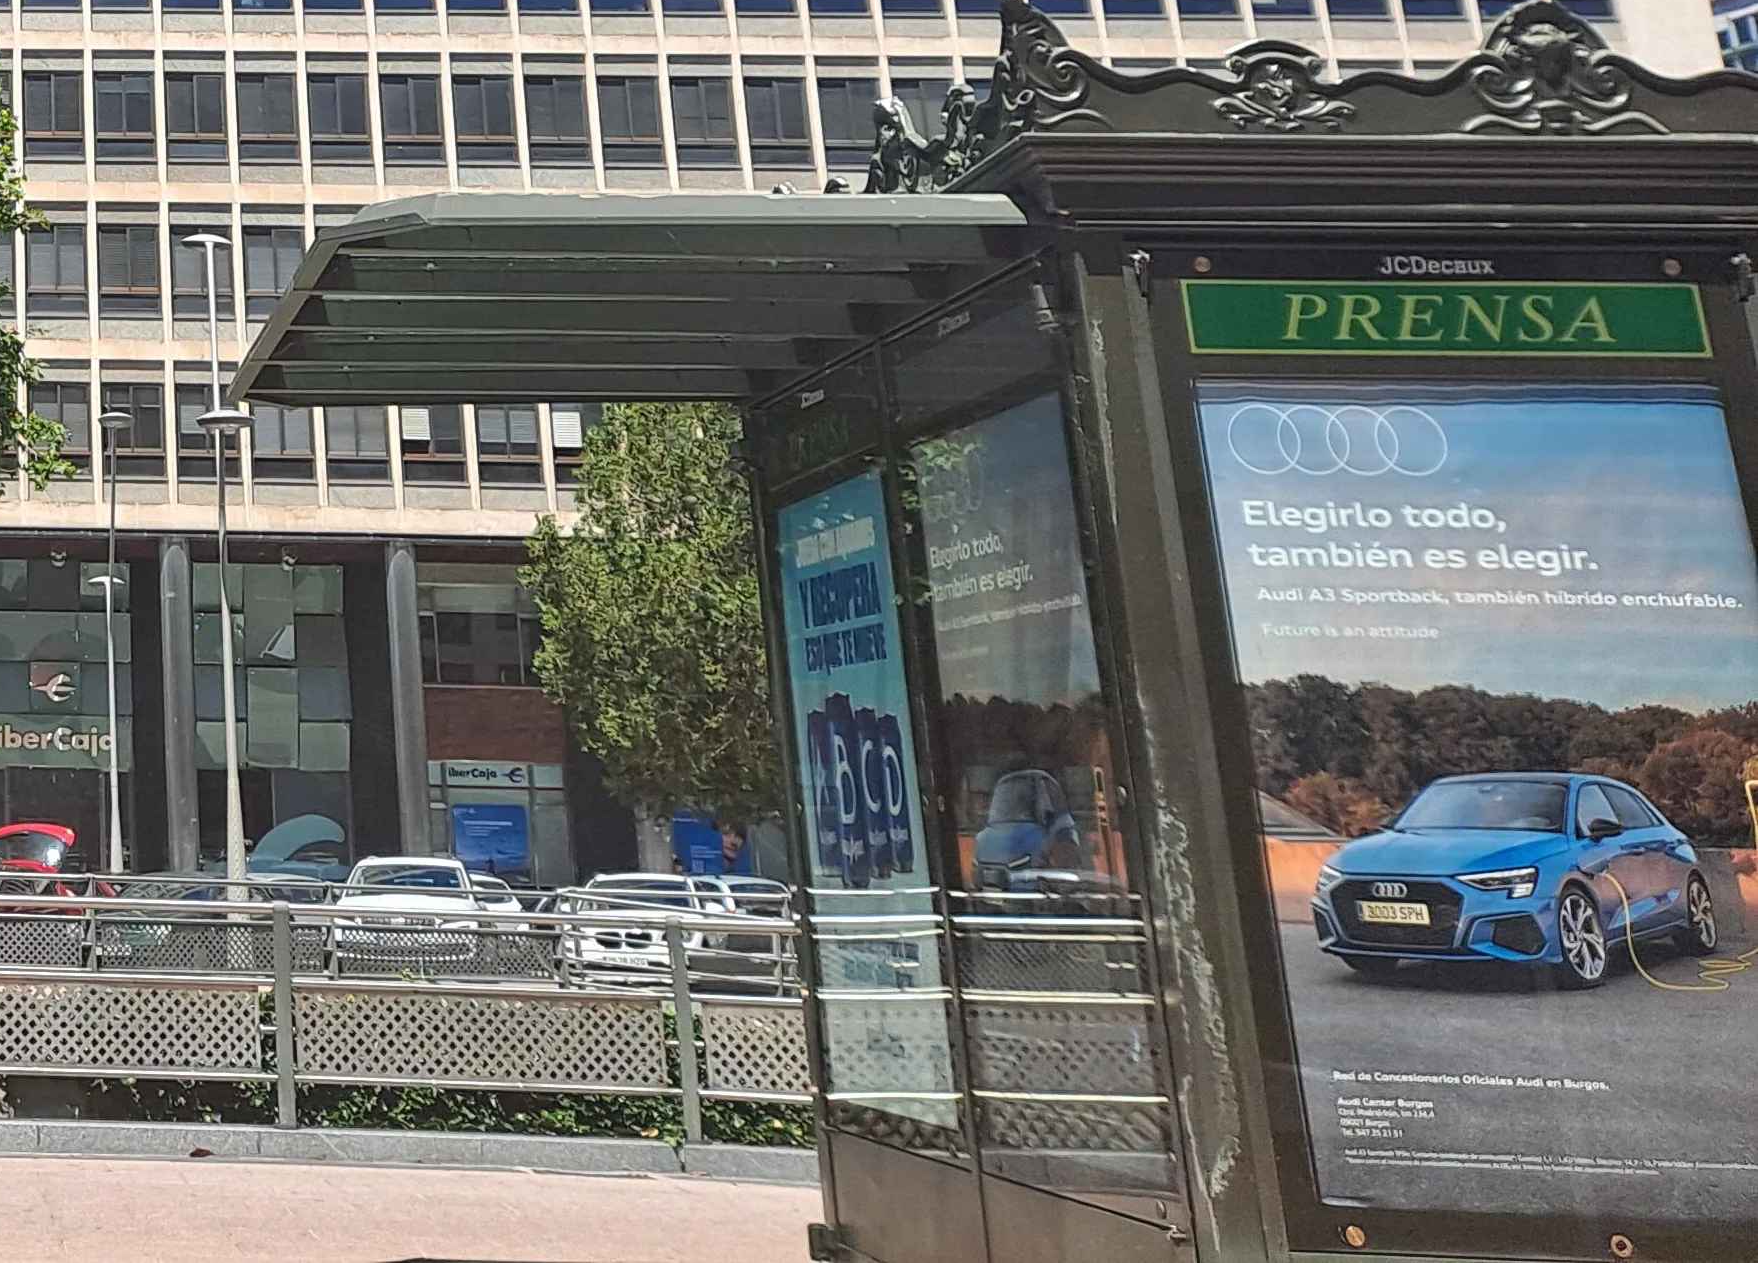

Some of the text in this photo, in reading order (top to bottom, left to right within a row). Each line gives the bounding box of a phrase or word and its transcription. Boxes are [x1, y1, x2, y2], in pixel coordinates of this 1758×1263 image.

[1380, 255, 1495, 276] JCDecaux
[1282, 292, 1617, 344] PRENSA
[1241, 500, 1507, 534] Elegirlo todo,
[1247, 541, 1599, 576] también es elegir.
[1257, 588, 1304, 602] Audi
[1309, 588, 1336, 602] A3
[1341, 588, 1450, 606] Sportback,
[1454, 590, 1539, 605] también
[1622, 593, 1744, 609] enchufable.
[1262, 623, 1319, 638] Future
[1345, 626, 1364, 638] an
[1369, 624, 1440, 639] attitude
[448, 766, 497, 780] iberCaja
[1357, 1072, 1372, 1081] de
[1374, 1071, 1461, 1084] Concesionarios
[1462, 1074, 1514, 1085] Oficiales
[1516, 1077, 1544, 1087] Audi
